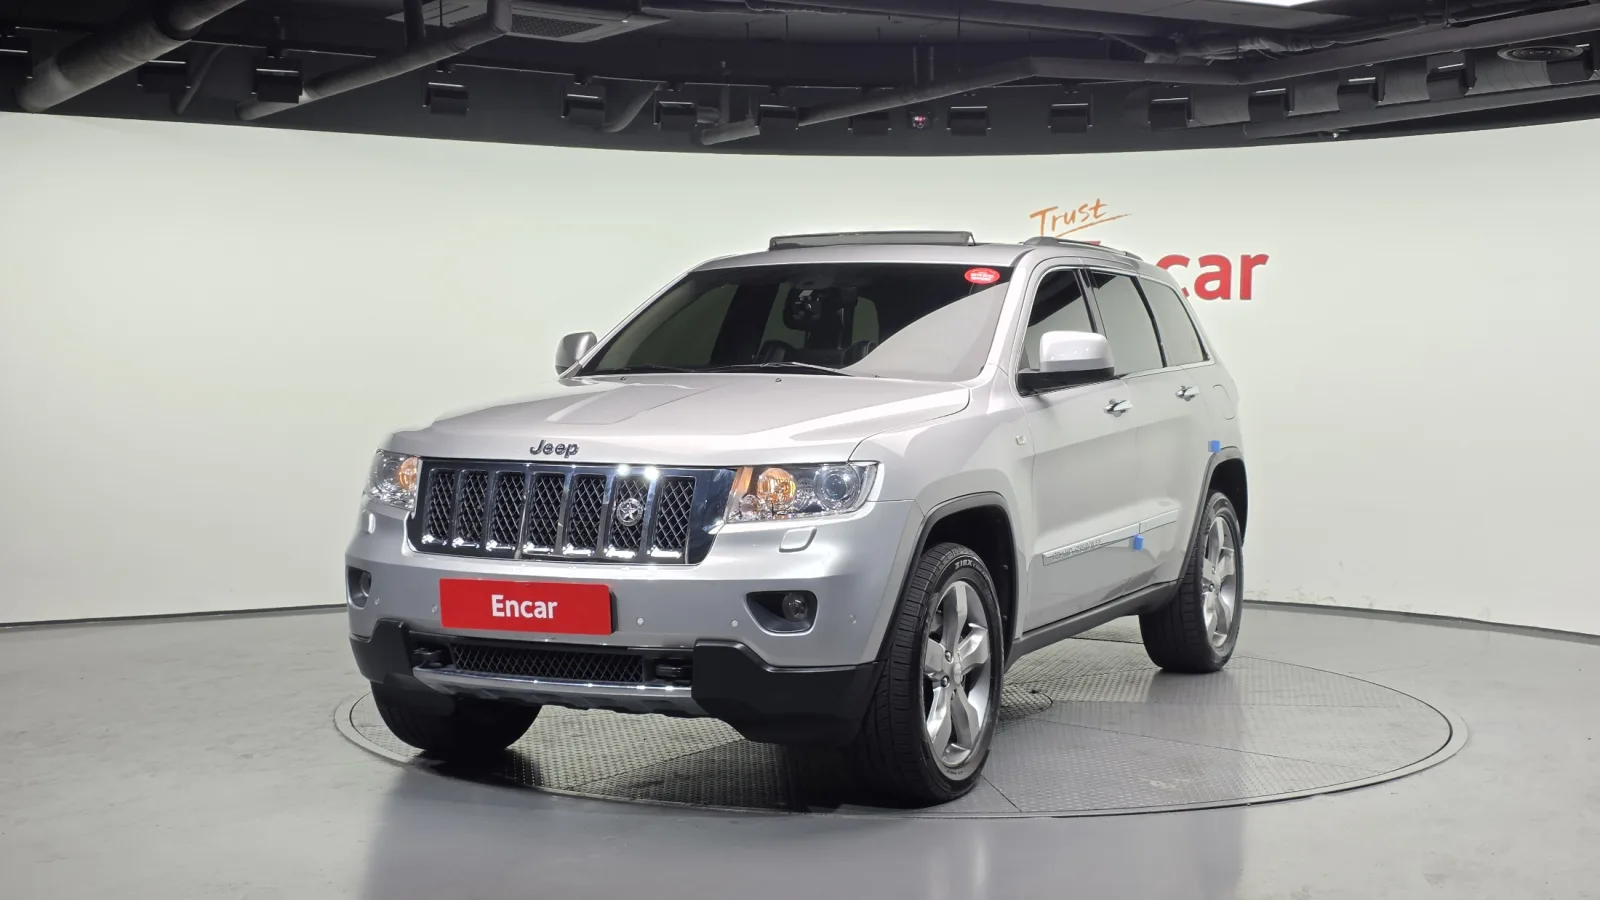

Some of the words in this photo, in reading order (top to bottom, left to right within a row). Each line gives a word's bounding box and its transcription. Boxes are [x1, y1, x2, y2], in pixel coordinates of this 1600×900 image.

[1030, 198, 1107, 236] Trust
[529, 439, 579, 458] Jeep
[491, 594, 557, 619] Encar
